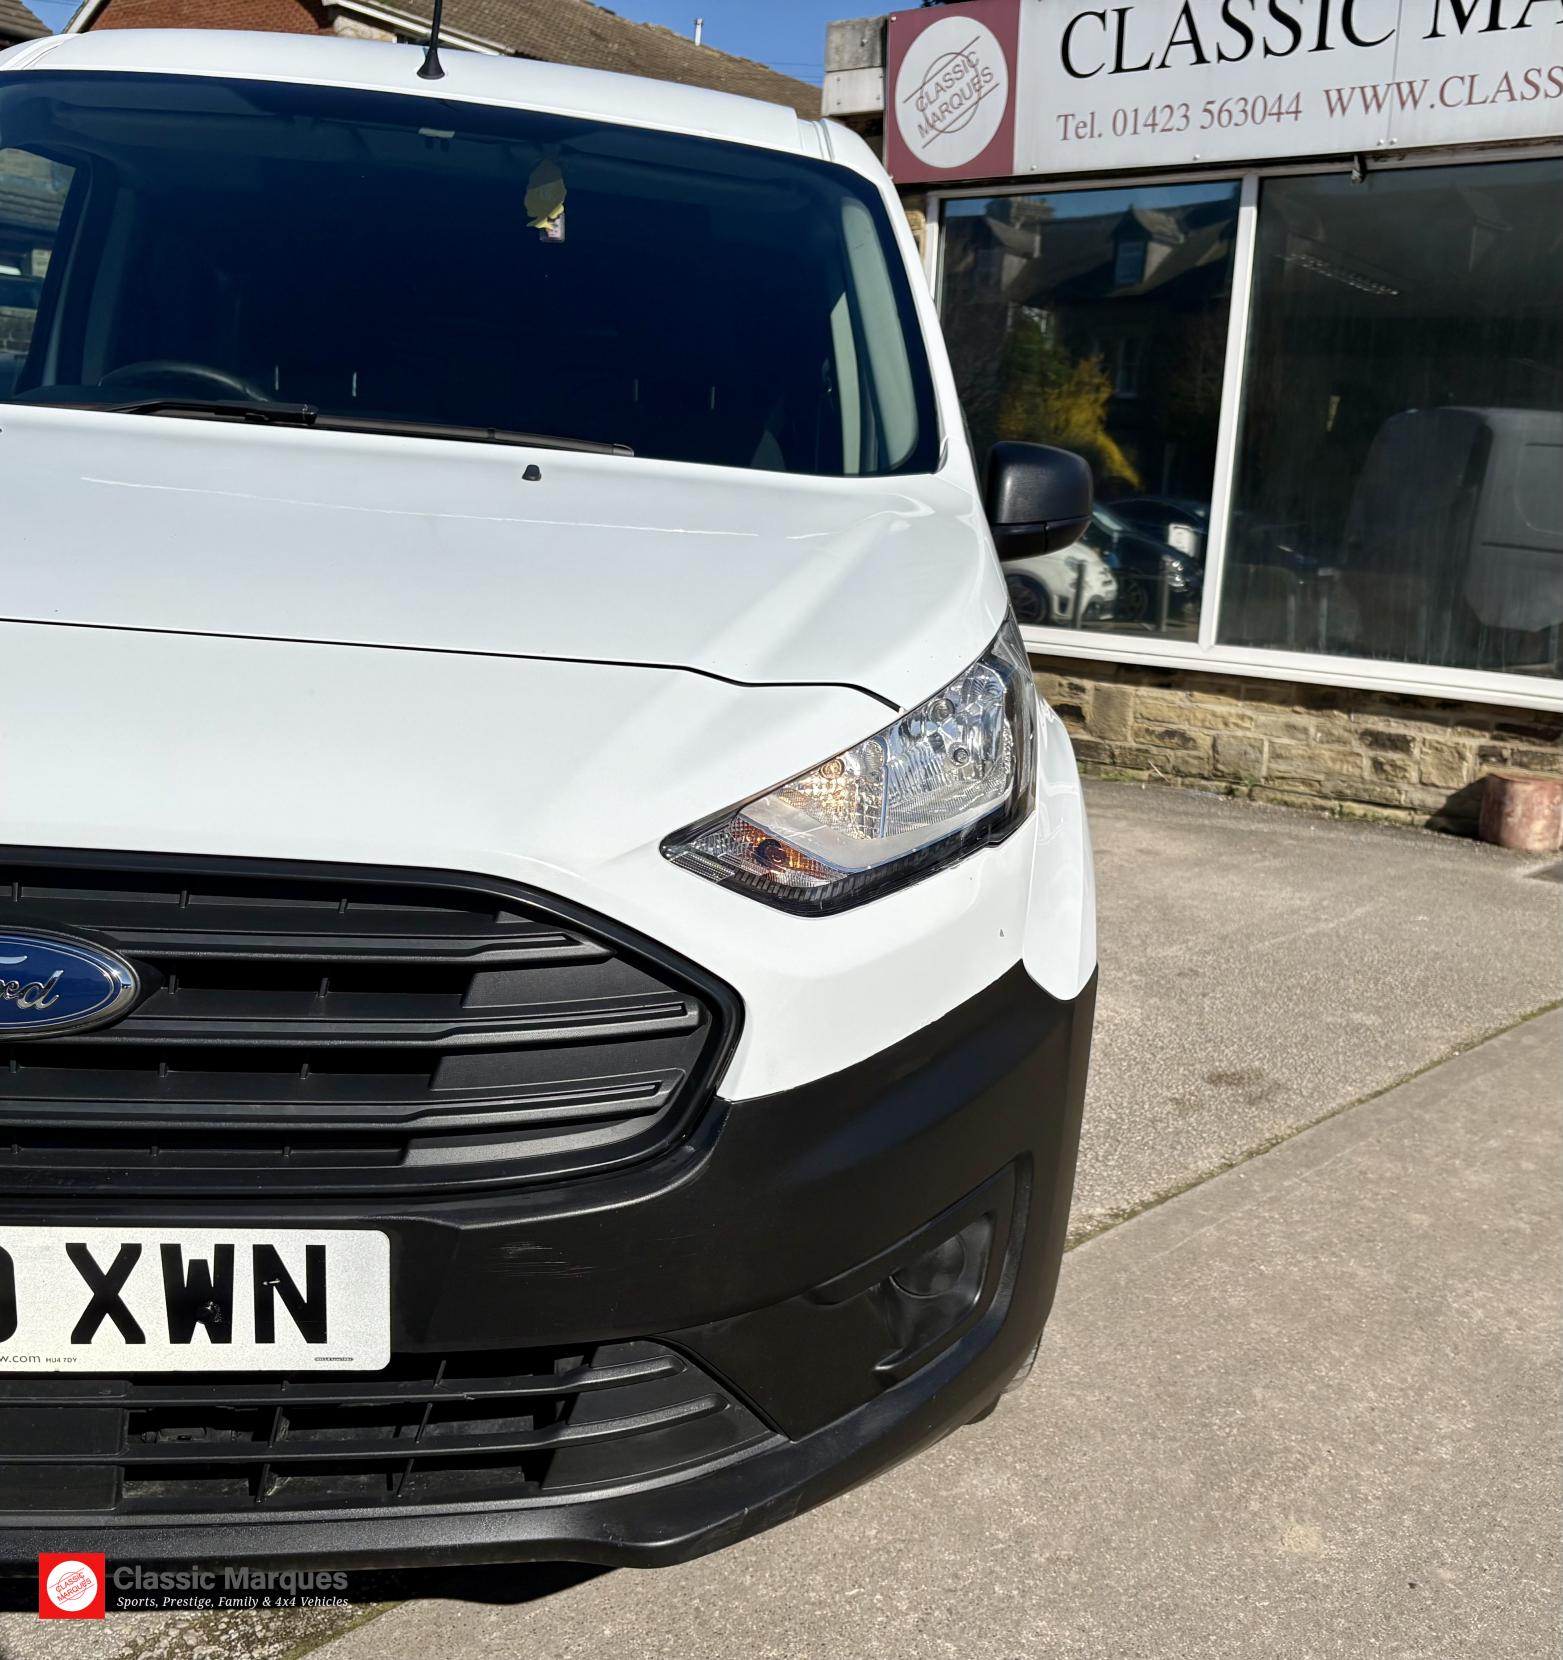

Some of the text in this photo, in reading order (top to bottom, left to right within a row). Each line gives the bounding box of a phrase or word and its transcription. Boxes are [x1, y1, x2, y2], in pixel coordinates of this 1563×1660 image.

[1060, 0, 1397, 79] CLASSIC
[915, 51, 980, 113] CLASSIC
[916, 66, 994, 139] MARQUES
[1056, 65, 1563, 141] Tel. 01423 563044 WWW.CLASS
[65, 1242, 328, 1345] XWN
